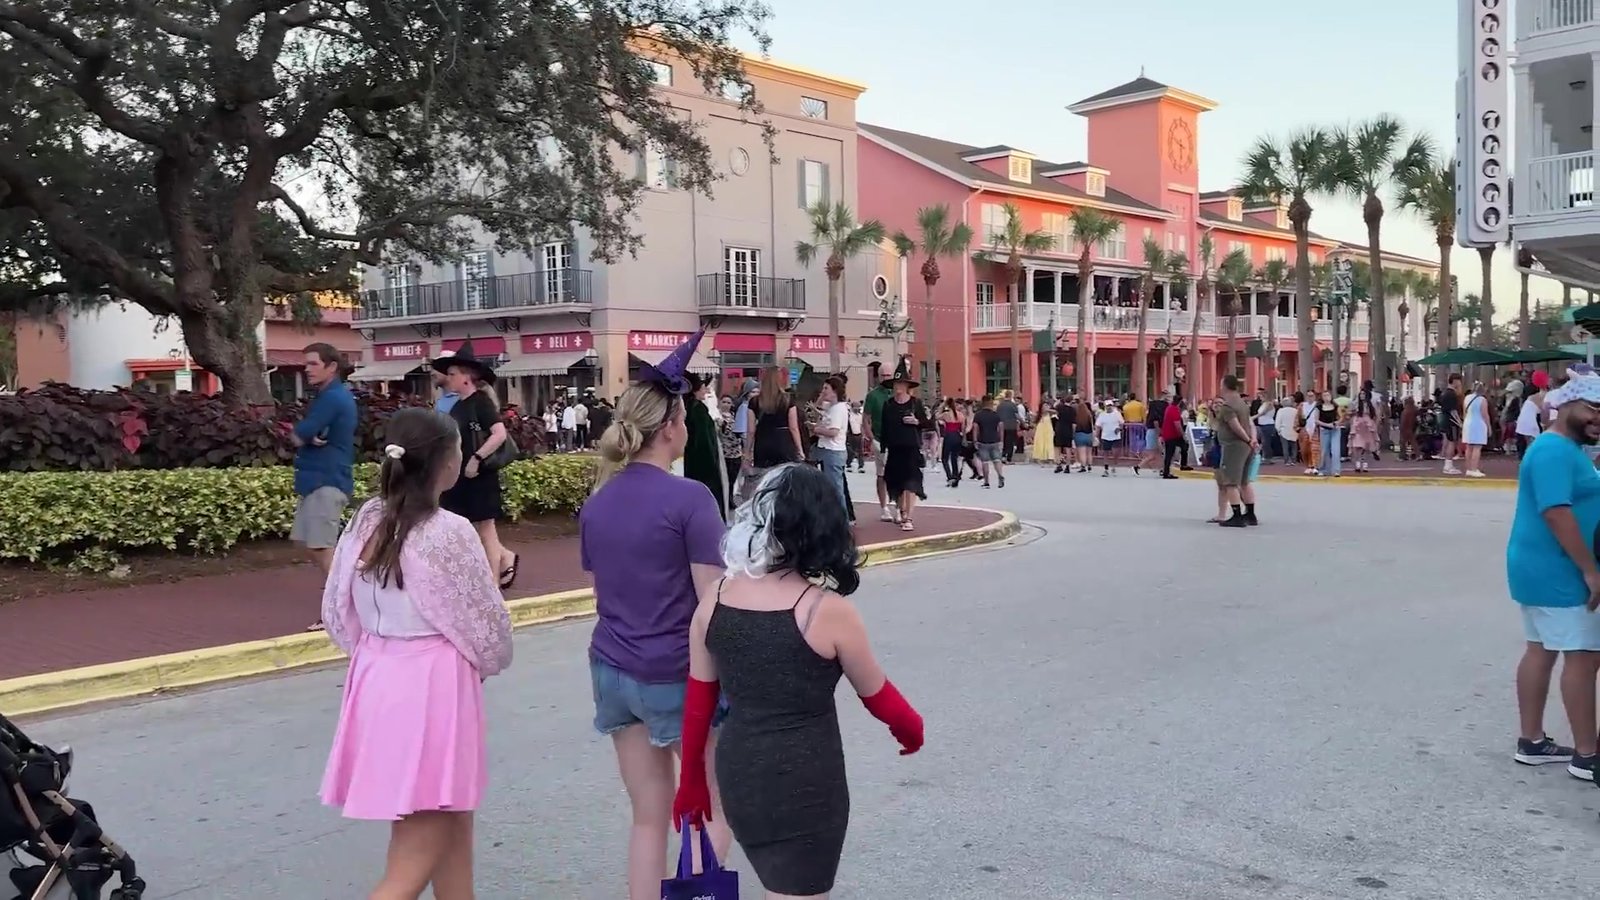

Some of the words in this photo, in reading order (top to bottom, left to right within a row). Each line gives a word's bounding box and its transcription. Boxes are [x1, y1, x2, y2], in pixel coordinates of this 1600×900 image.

[549, 336, 568, 348] DELI
[645, 334, 679, 346] MARKET
[808, 338, 826, 349] DELI
[392, 346, 414, 356] MARKET
